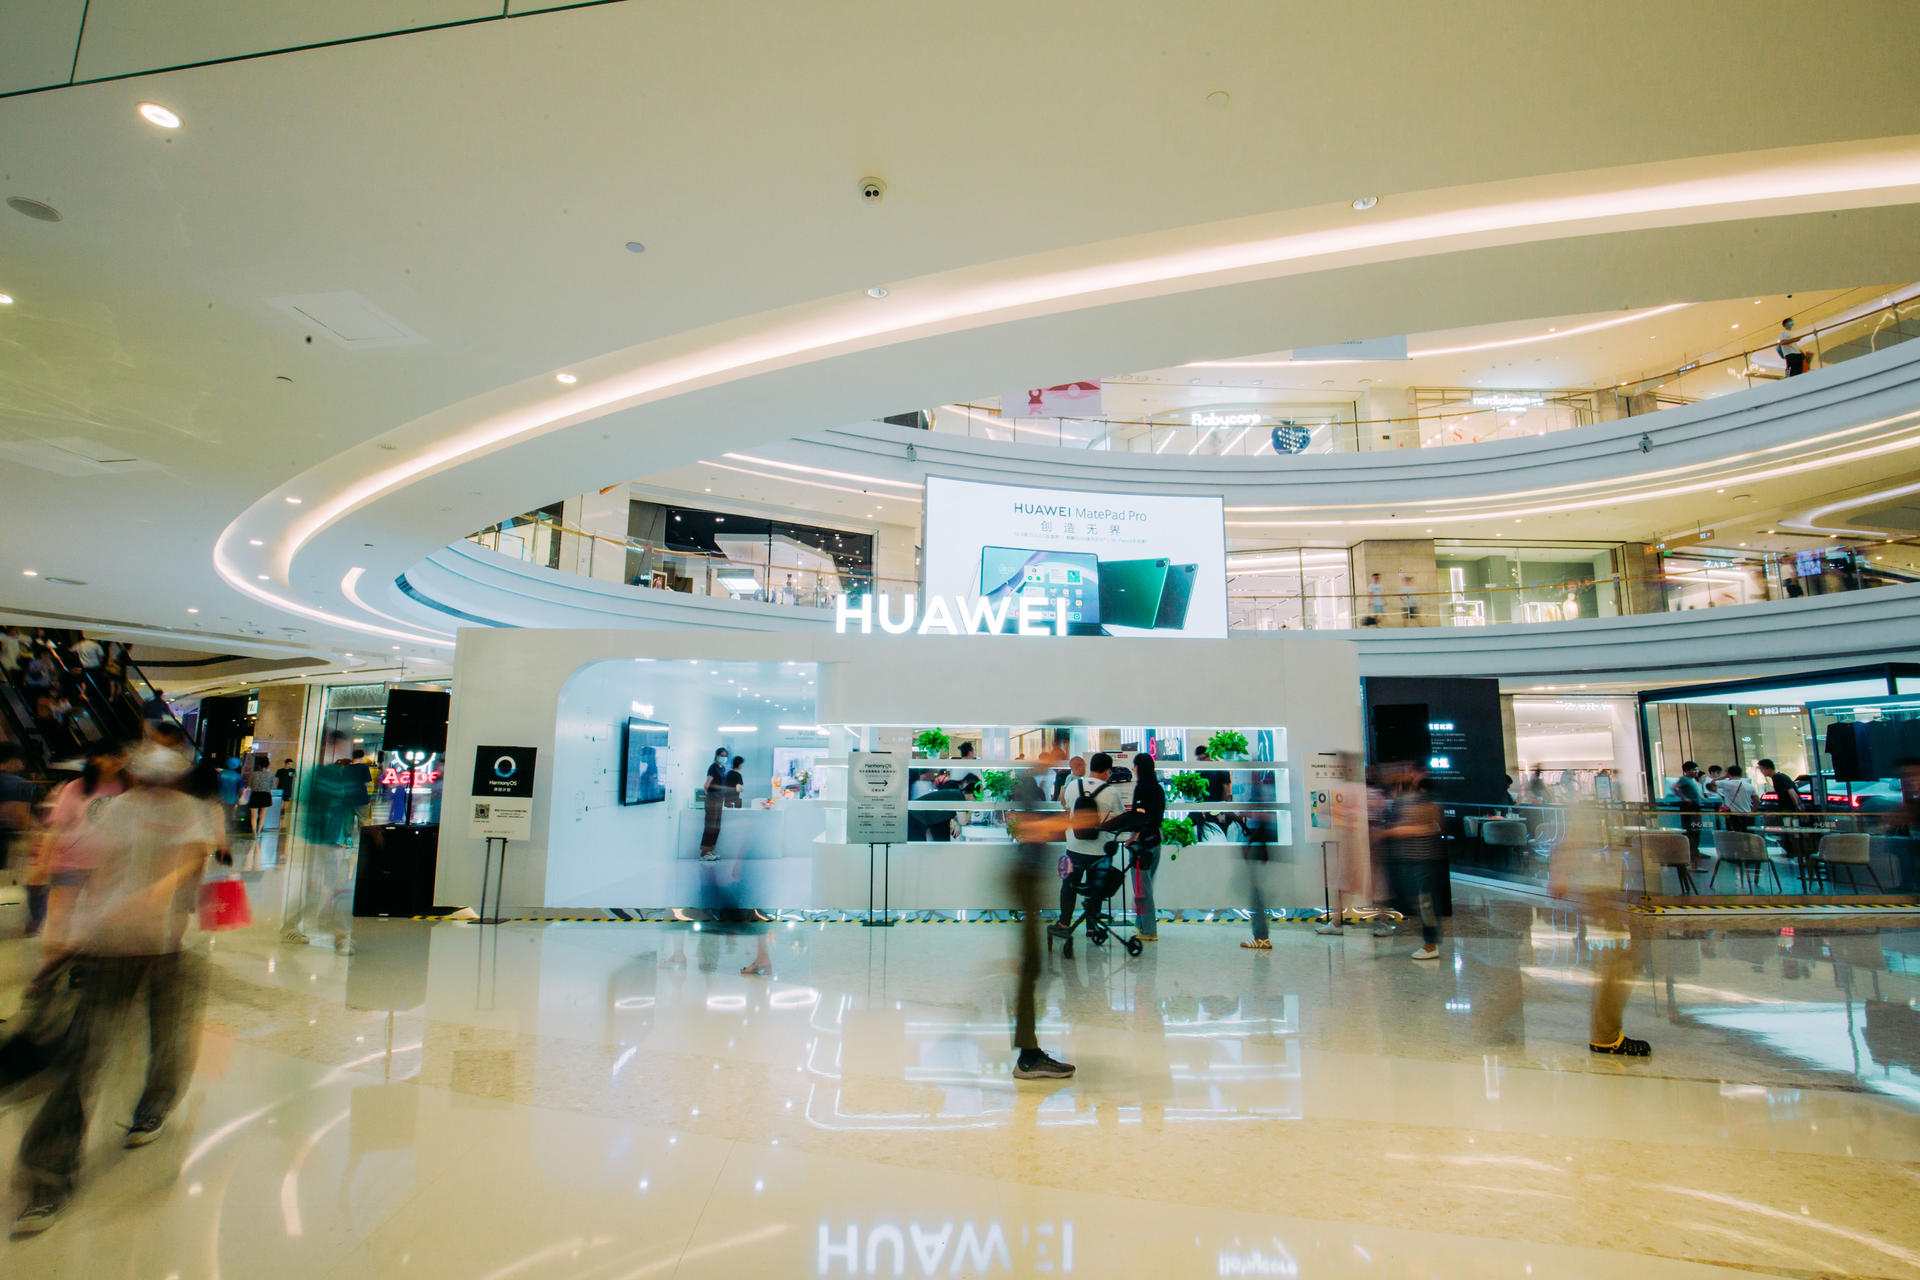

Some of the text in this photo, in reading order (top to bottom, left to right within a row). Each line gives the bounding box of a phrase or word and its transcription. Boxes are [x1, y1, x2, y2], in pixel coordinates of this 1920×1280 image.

[1014, 502, 1147, 521] HUAWEI MatePad Pro
[1040, 520, 1120, 536] 创造无界
[835, 593, 1068, 637] HUAWEI
